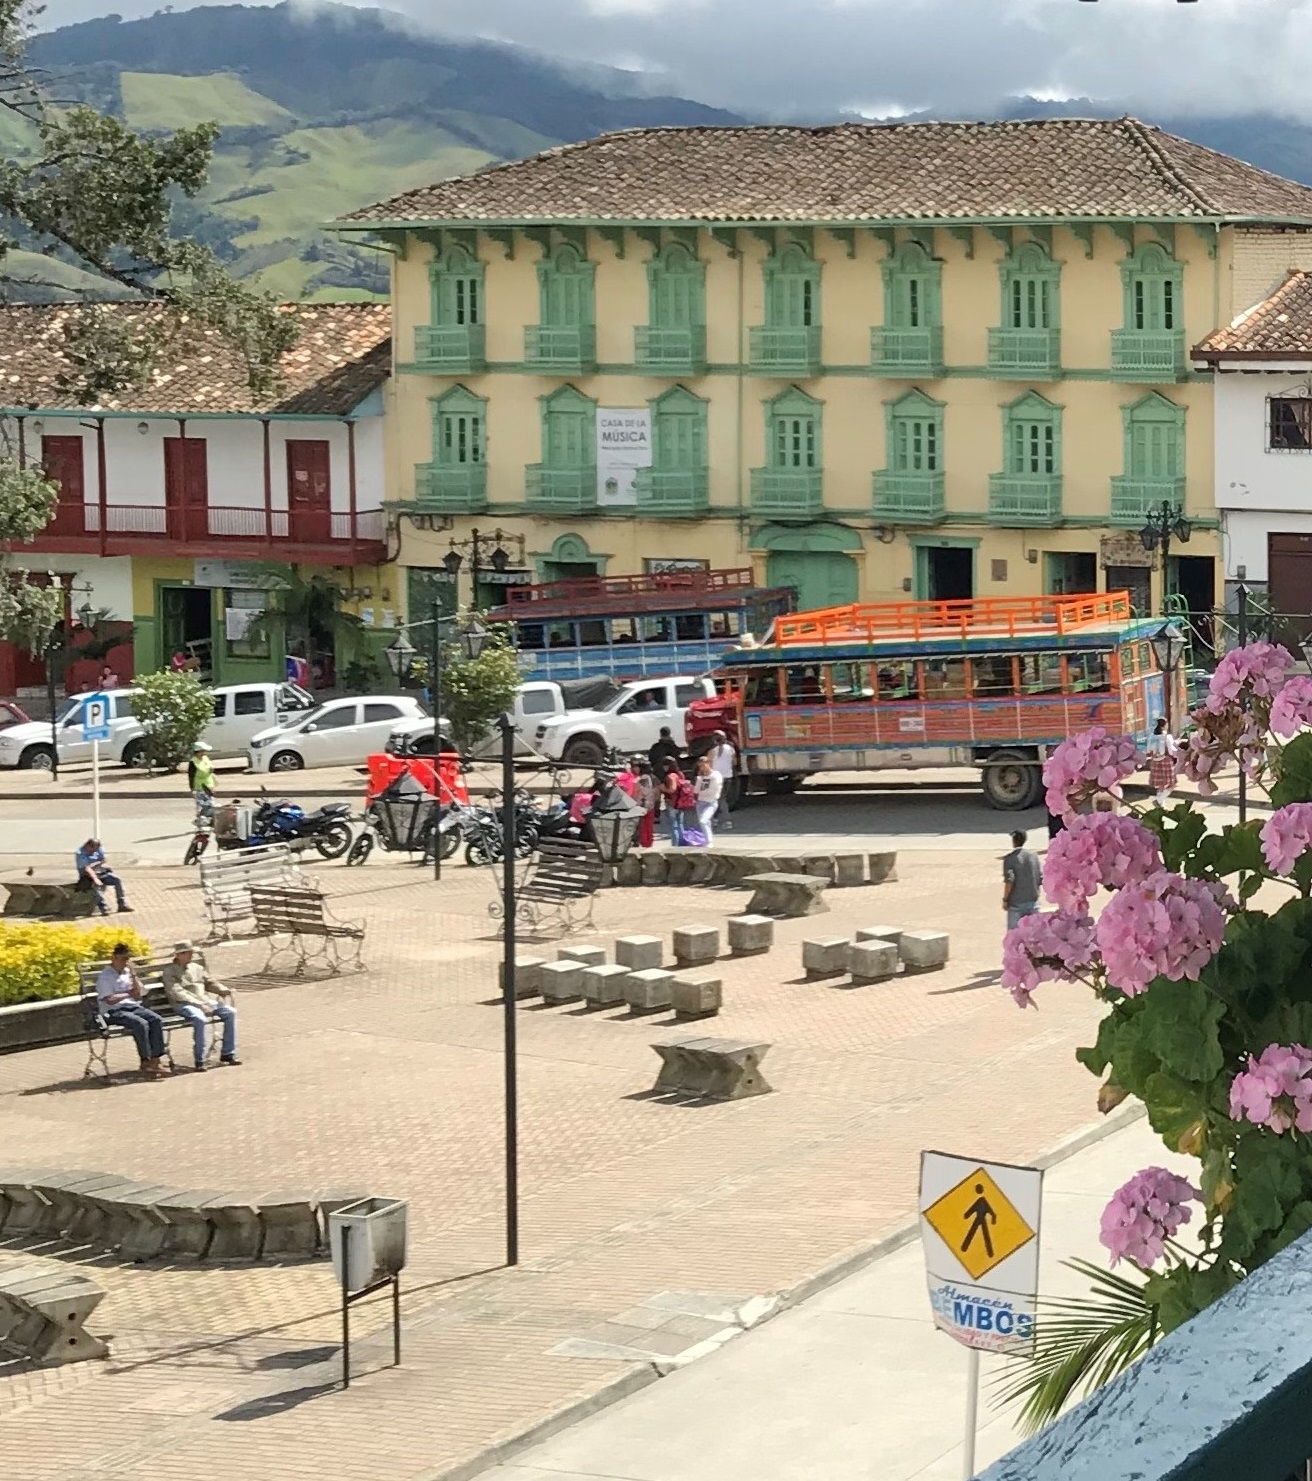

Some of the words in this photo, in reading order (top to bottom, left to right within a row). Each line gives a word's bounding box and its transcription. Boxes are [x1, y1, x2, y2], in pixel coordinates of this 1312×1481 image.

[601, 419, 623, 427] CASA
[625, 419, 634, 427] DE
[637, 419, 647, 427] LA
[602, 429, 647, 442] MÚSICA
[91, 703, 101, 725] P
[938, 1285, 1015, 1311] Almacén
